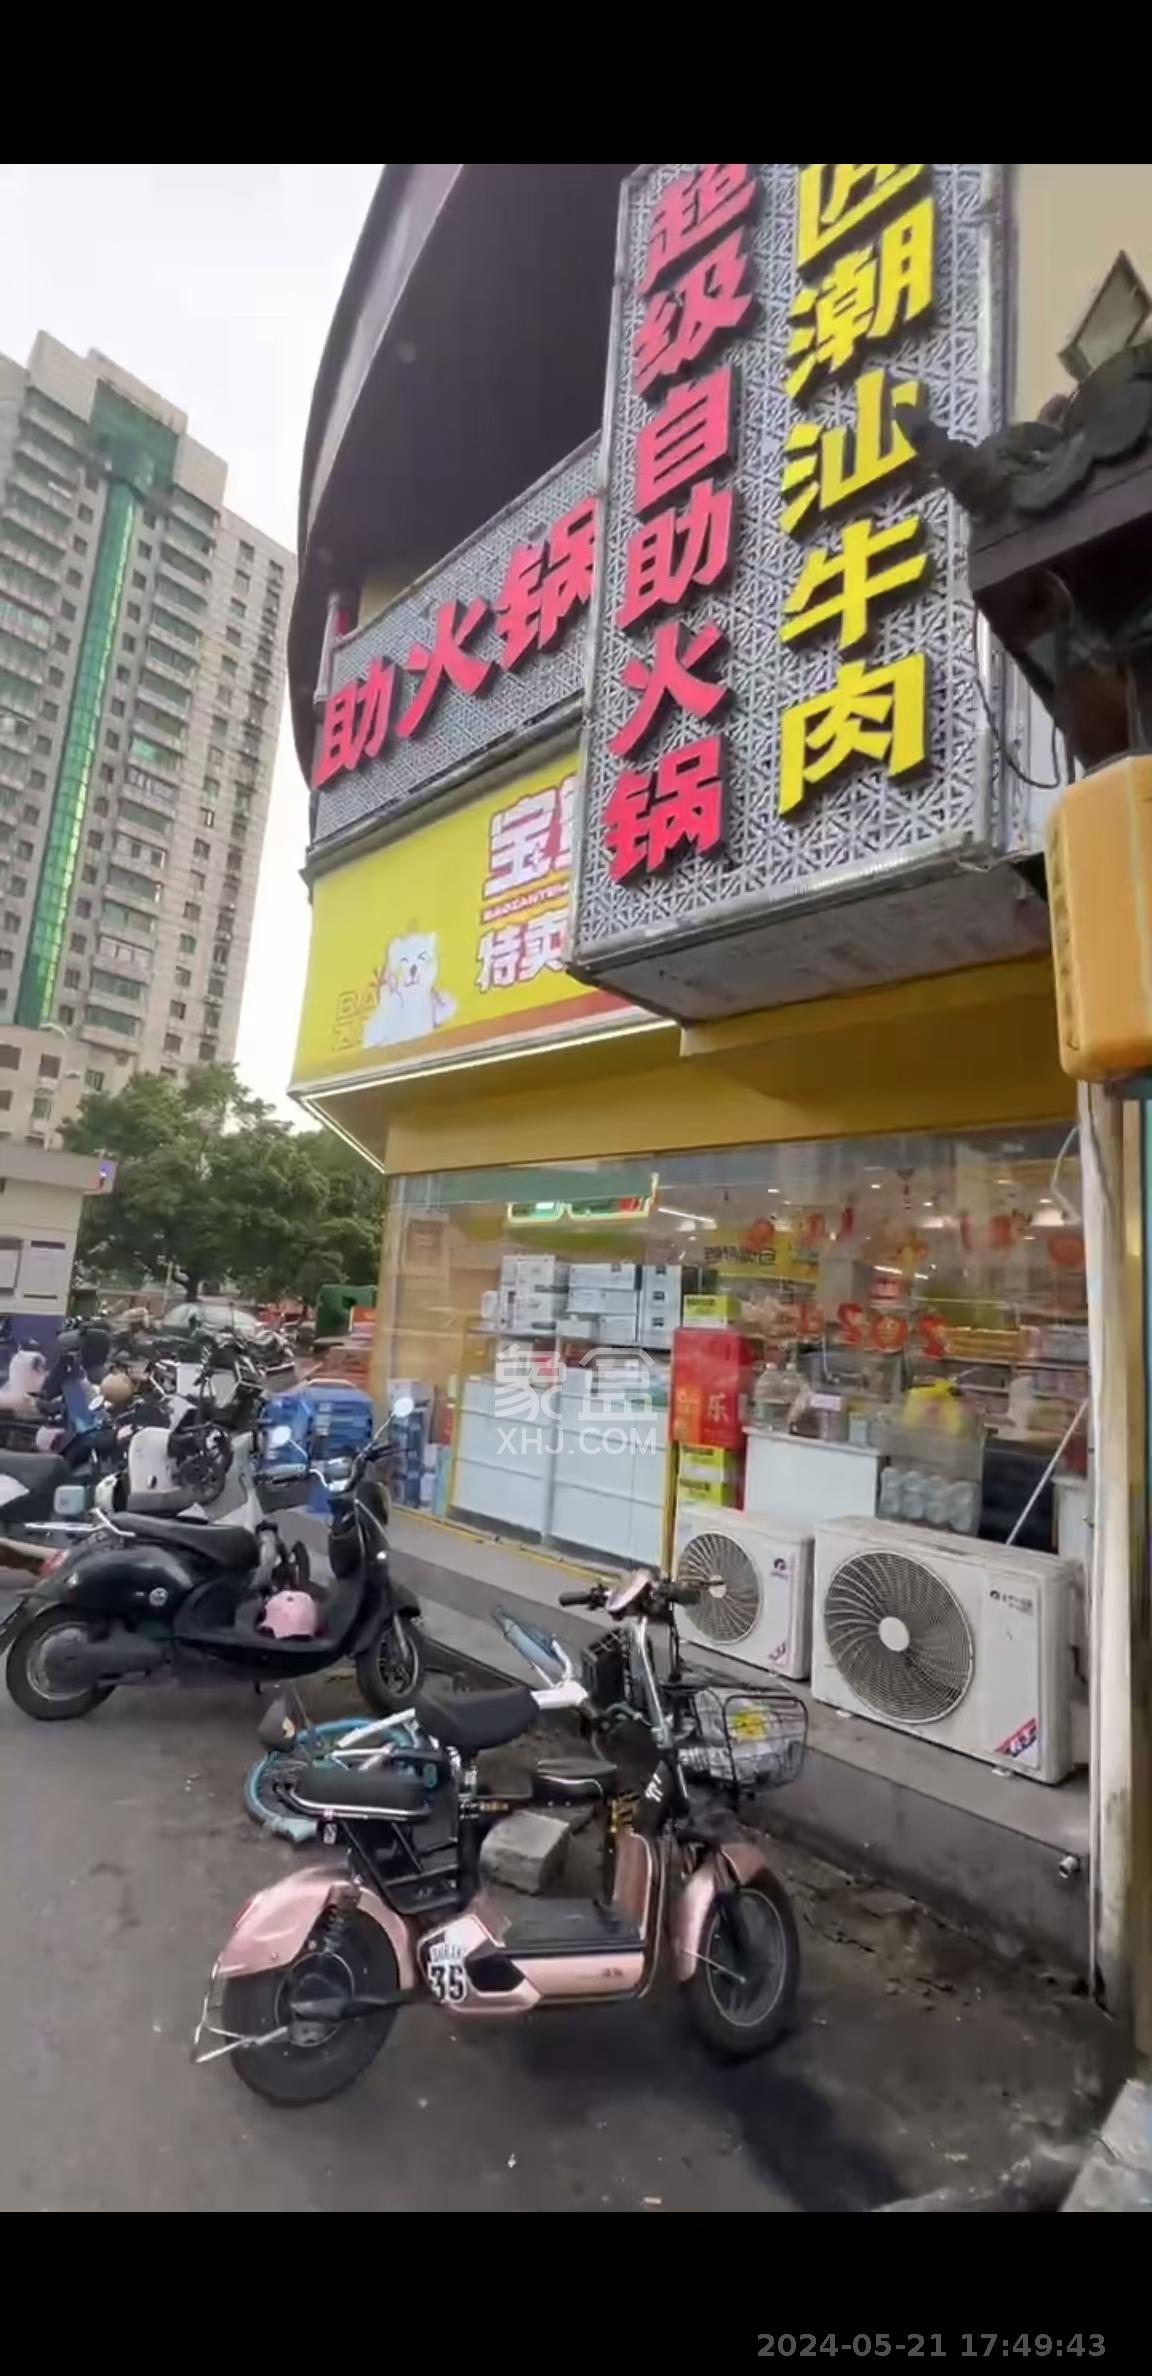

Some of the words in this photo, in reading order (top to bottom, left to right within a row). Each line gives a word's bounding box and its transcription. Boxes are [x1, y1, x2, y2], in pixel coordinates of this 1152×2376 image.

[604, 164, 756, 884] 超级自助火锅
[484, 775, 576, 899] 宝
